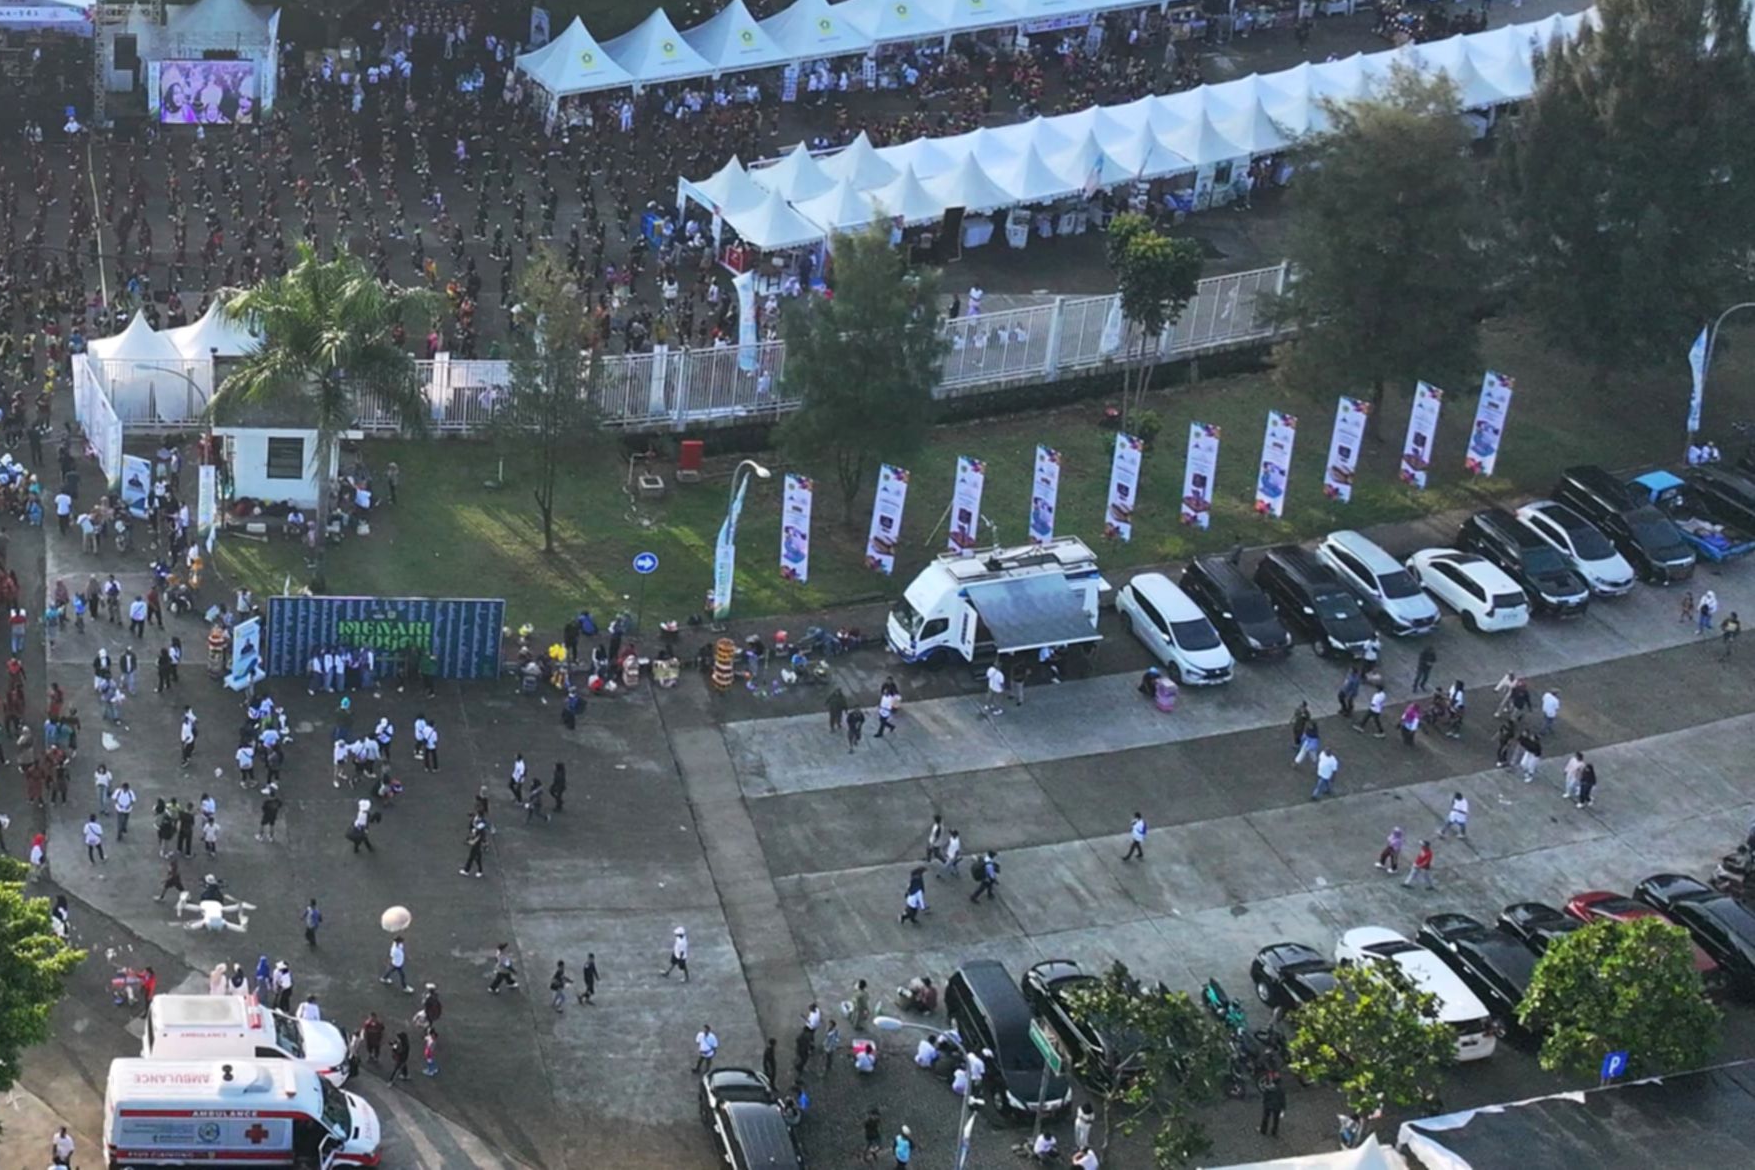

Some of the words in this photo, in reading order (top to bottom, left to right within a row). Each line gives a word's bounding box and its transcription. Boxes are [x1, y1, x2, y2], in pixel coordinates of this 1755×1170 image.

[338, 621, 431, 635] MENARI
[1608, 1055, 1621, 1075] P
[134, 1073, 212, 1084] AMBULANCE
